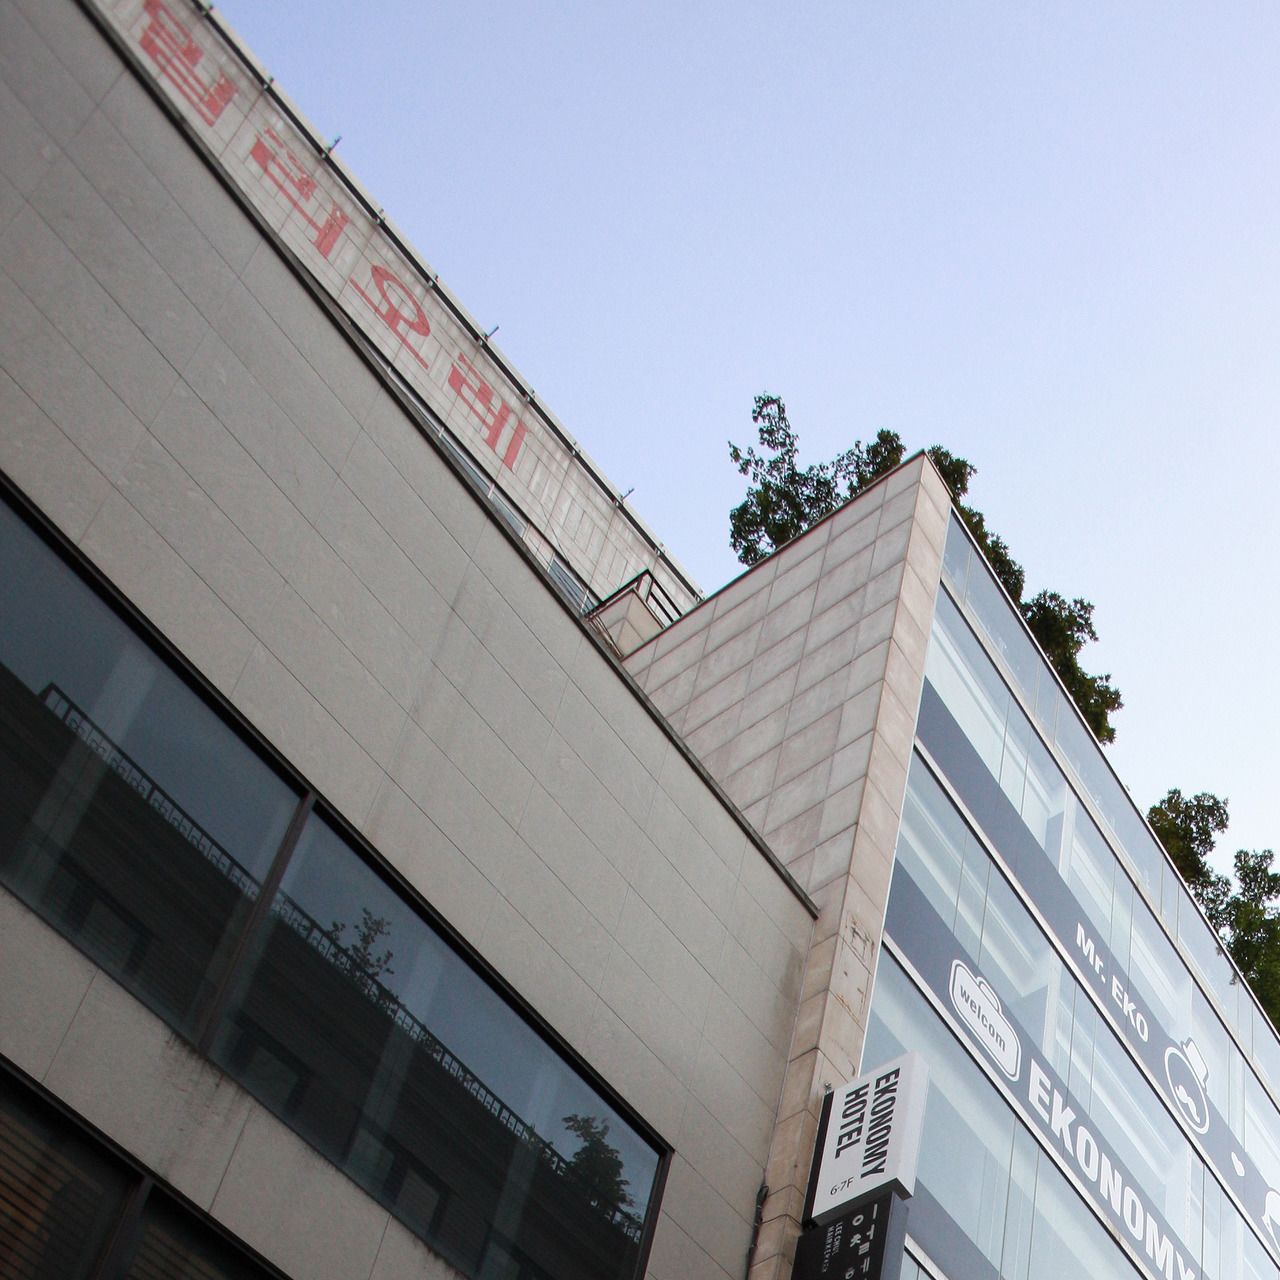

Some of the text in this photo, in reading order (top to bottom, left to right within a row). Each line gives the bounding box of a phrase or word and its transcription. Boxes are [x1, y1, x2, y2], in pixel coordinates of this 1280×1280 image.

[1075, 922, 1149, 1043] Mr. EKO
[834, 1083, 870, 1160] HOTEL
[861, 1067, 900, 1179] EKONOMY
